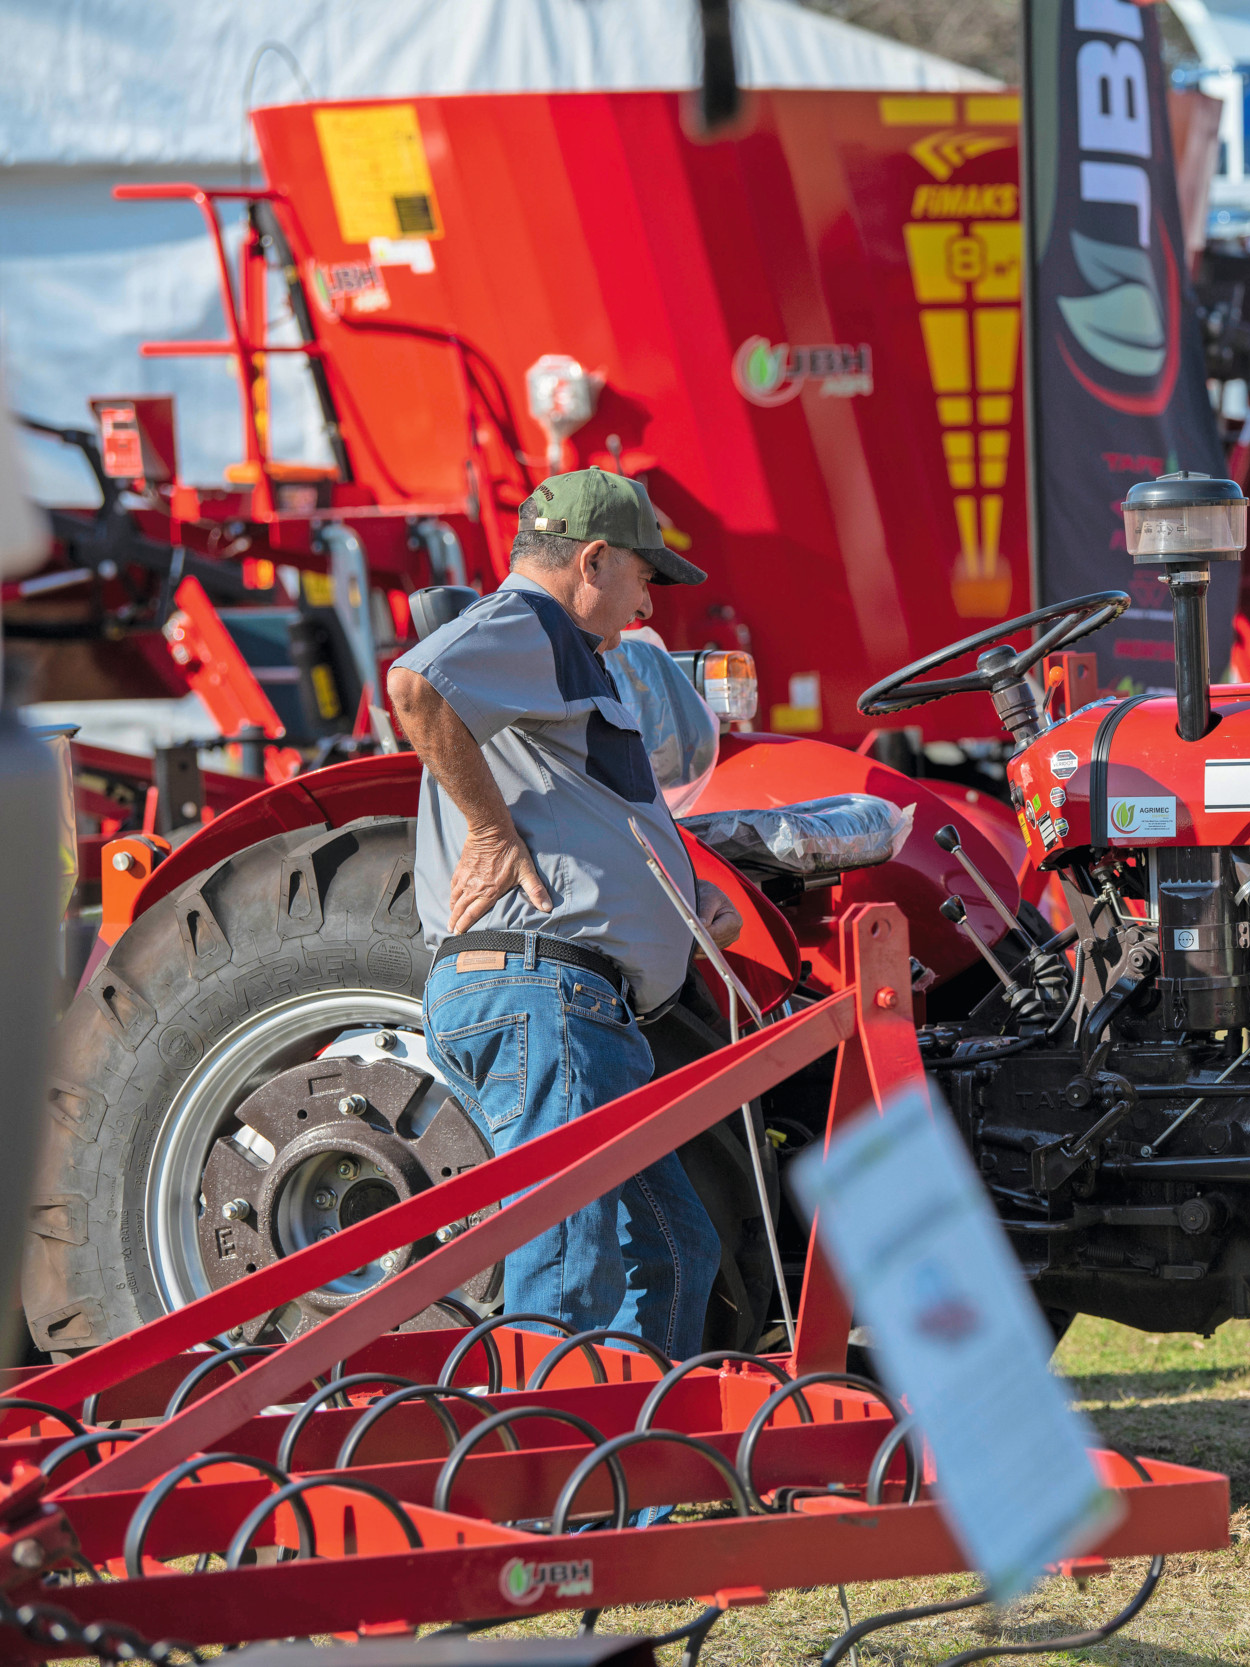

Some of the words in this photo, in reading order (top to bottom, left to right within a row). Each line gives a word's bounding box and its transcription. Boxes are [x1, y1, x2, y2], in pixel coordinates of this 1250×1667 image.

[786, 346, 870, 378] JBH
[201, 946, 357, 1037] MRF
[108, 1110, 128, 1150] NYLON
[121, 1210, 130, 1242] RATING
[534, 1561, 591, 1585] JBH
